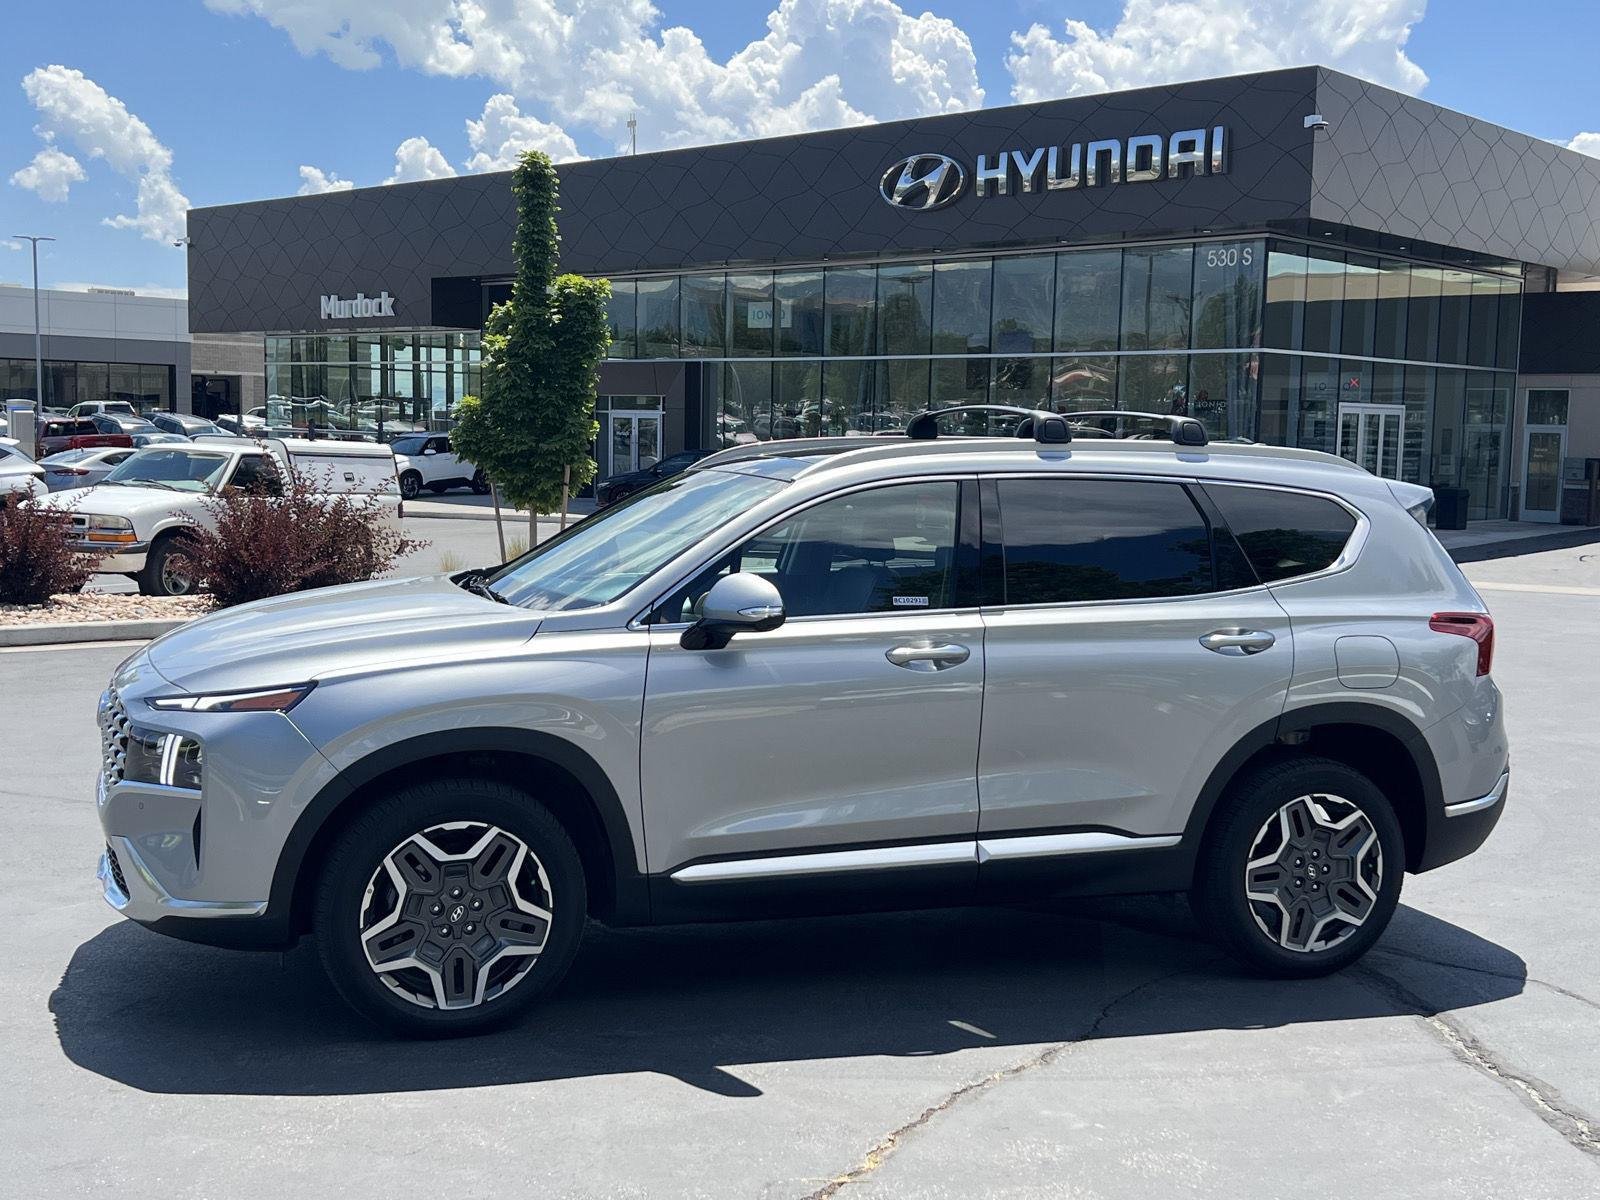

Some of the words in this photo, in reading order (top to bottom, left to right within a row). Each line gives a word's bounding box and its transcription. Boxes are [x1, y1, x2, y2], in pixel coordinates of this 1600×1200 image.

[976, 125, 1225, 197] HYUNDAI
[1207, 249, 1237, 267] 530
[1242, 248, 1252, 265] S
[320, 291, 395, 319] Murdock
